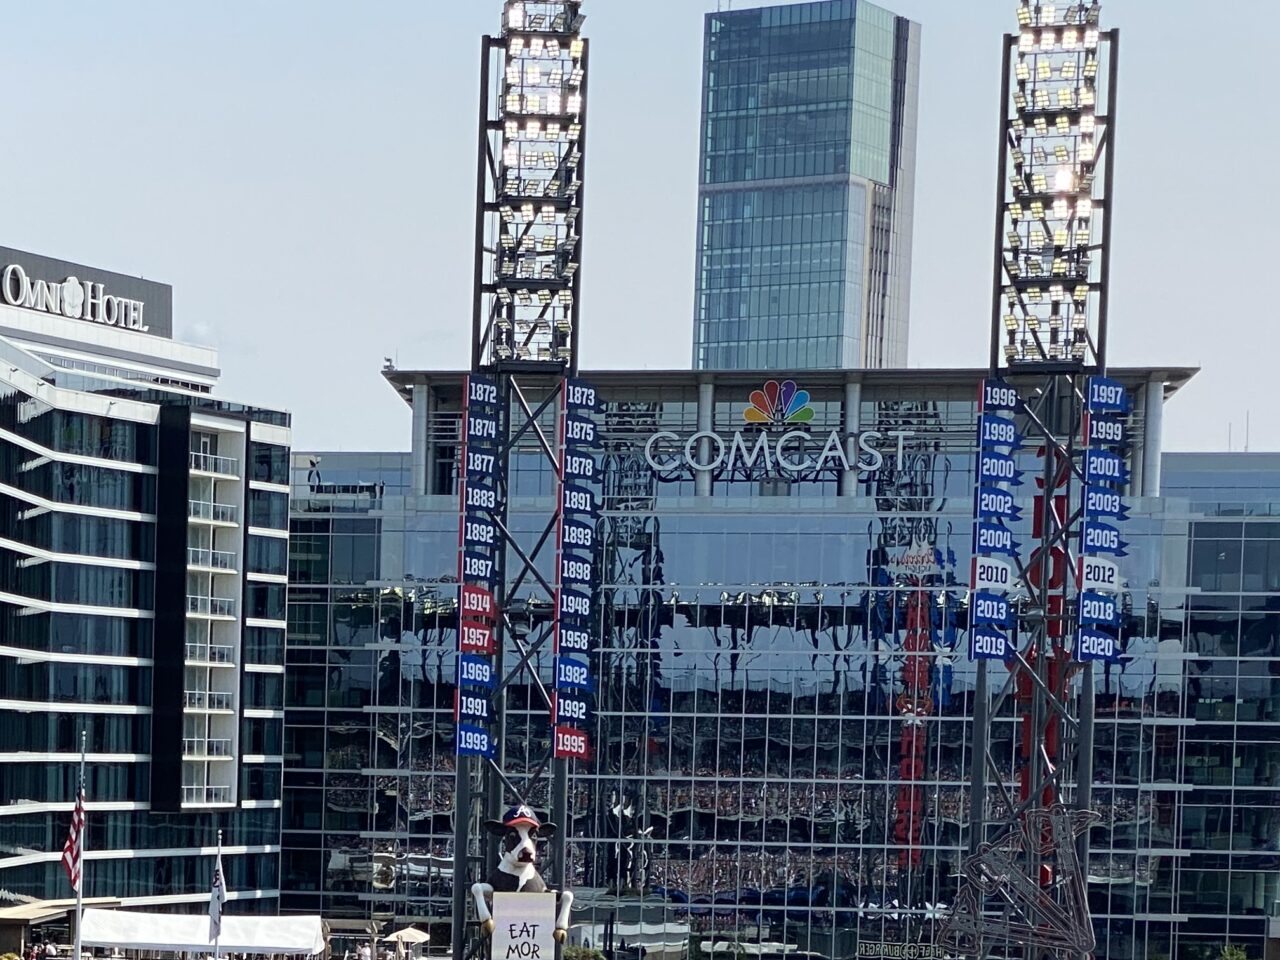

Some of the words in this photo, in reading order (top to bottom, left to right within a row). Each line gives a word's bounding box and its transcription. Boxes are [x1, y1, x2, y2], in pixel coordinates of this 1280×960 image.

[470, 382, 497, 403] 1872
[568, 386, 595, 406] 1873
[986, 386, 1016, 406] 1996
[1092, 385, 1123, 405] 1997
[469, 417, 496, 438] 1874
[567, 421, 594, 442] 1875
[984, 422, 1014, 442] 1998
[1091, 421, 1122, 440] 1999
[644, 431, 915, 471] COMCAST
[468, 452, 494, 473] 1877
[566, 455, 593, 475] 1878
[983, 458, 1014, 478] 2000
[1090, 456, 1120, 476] 2001
[467, 487, 495, 508] 1883
[565, 490, 591, 511] 1891
[982, 494, 1012, 514] 2002
[1088, 492, 1120, 512] 2003
[466, 522, 493, 543] 1892
[564, 525, 591, 546] 1893
[980, 529, 1011, 549] 2004
[1087, 528, 1118, 548] 2005
[465, 556, 492, 577] 1897
[563, 559, 591, 580] 1898
[979, 565, 1008, 584] 2010
[1086, 564, 1114, 584] 2012
[464, 592, 490, 612] 1914
[562, 594, 590, 615] 1948
[976, 600, 1006, 620] 2013
[1084, 600, 1114, 620] 2018
[463, 626, 490, 647] 1957
[561, 630, 588, 651] 1958
[976, 635, 1004, 655] 2019
[1082, 636, 1113, 656] 2020
[462, 661, 490, 682] 1969
[560, 664, 588, 684] 1982
[461, 696, 488, 717] 1991
[559, 699, 586, 719] 1992
[460, 730, 488, 751] 1993
[558, 733, 585, 754] 1995
[509, 922, 540, 940] EAT
[506, 942, 540, 960] MOR
